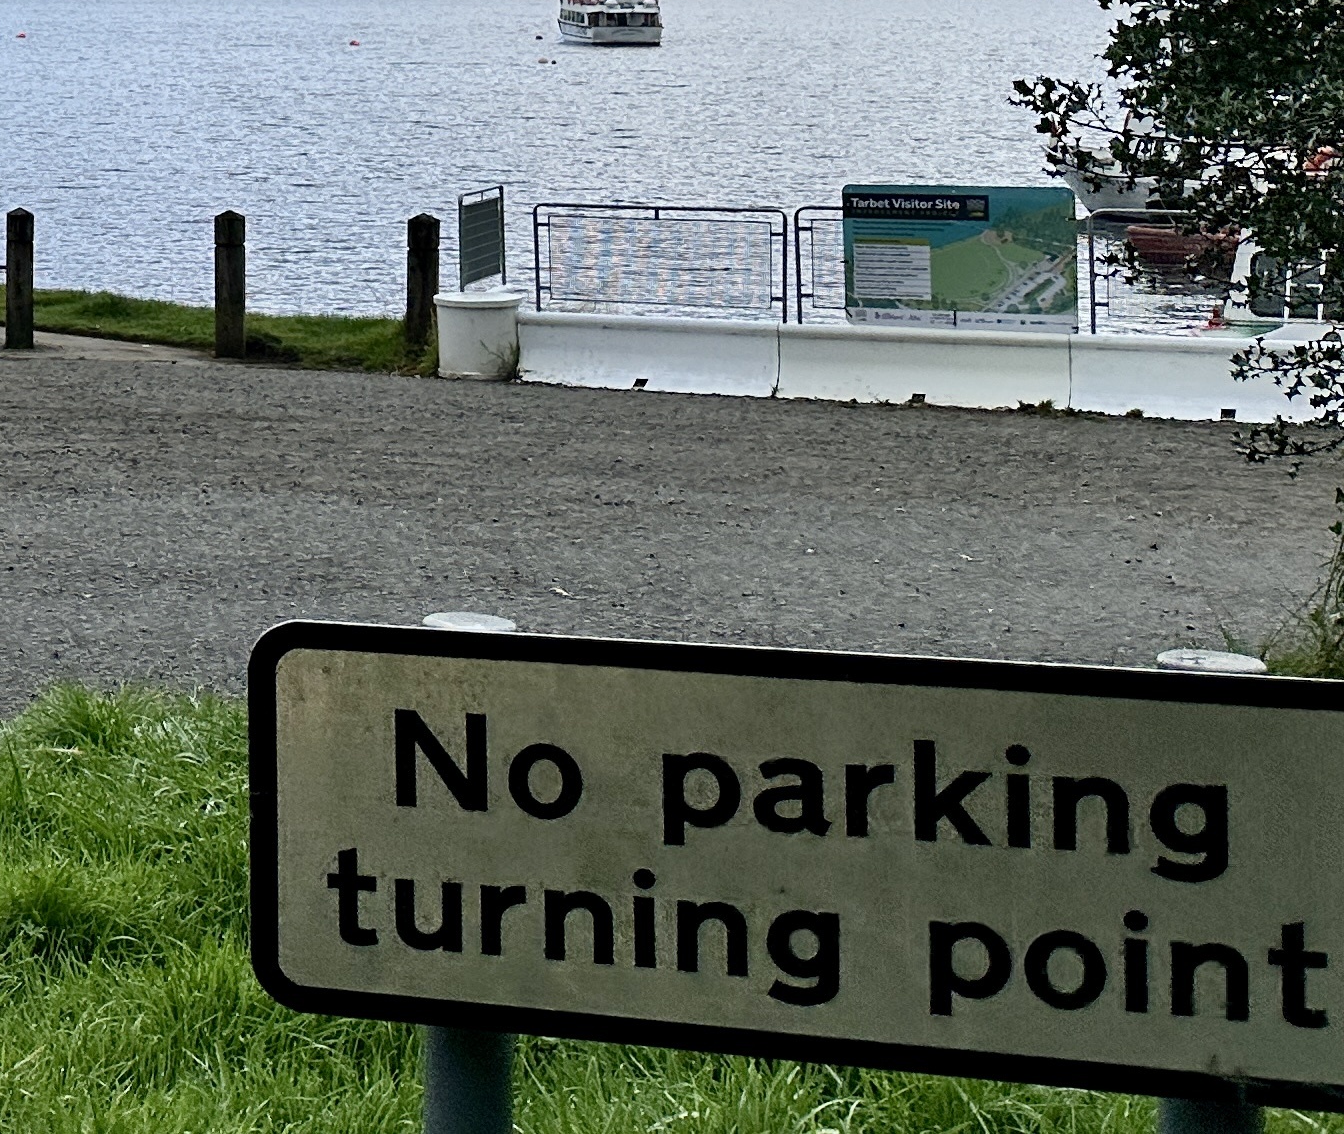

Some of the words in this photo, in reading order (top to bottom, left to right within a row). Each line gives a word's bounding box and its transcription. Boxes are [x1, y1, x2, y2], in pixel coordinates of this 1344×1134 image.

[850, 197, 891, 209] Tarbet
[891, 198, 934, 210] Visitor
[393, 708, 583, 821] No
[662, 739, 1229, 883] parking
[326, 847, 842, 1007] turning
[928, 910, 1329, 1029] point
